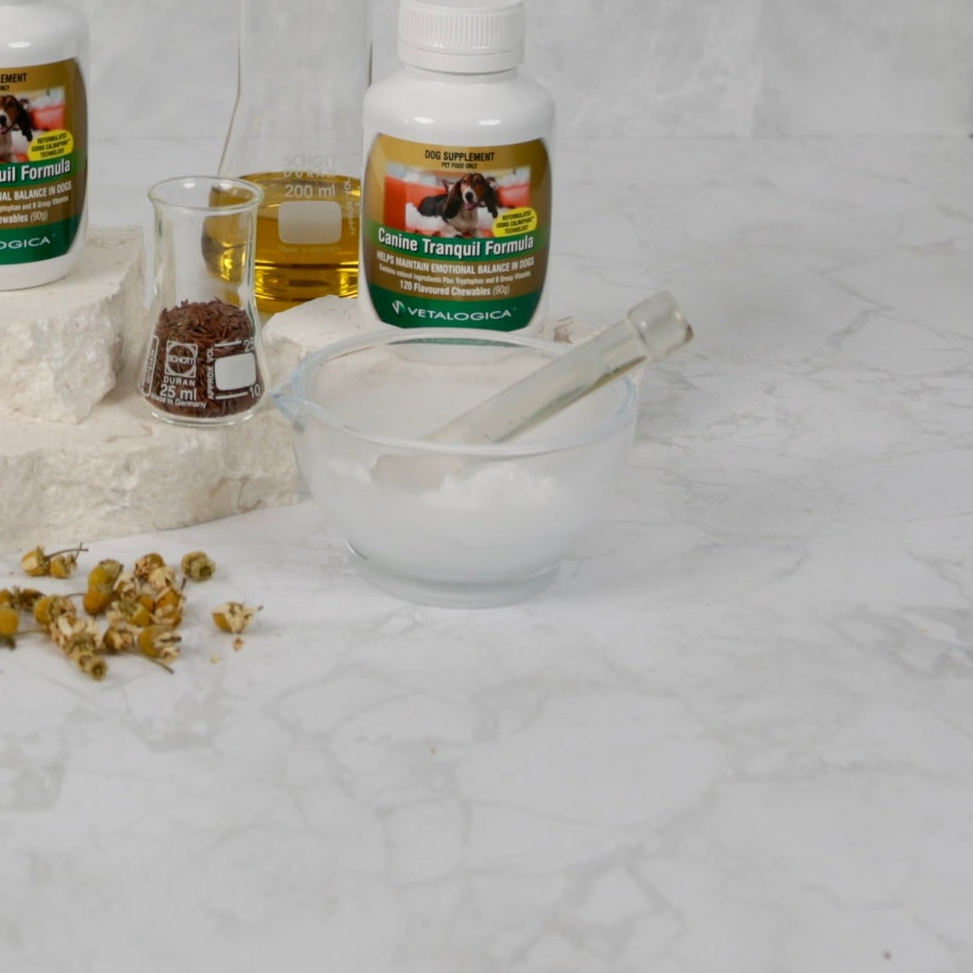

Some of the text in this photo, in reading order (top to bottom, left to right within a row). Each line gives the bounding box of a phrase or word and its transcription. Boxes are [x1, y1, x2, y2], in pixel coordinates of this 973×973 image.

[425, 150, 495, 162] DOG SUPPLEMENT
[20, 158, 70, 180] Formula
[14, 188, 47, 200] BALANCE
[48, 186, 56, 195] IN
[57, 181, 72, 192] DOGS
[284, 184, 336, 198] 200 ml
[378, 228, 534, 259] Canine Tranquil Formula
[376, 250, 534, 274] HELPS MAINTAIN EMOTIONAL BALANCE IN DOGS
[400, 280, 412, 290] 120
[414, 282, 449, 295] Flavoured
[451, 286, 490, 296] Chewables
[407, 307, 512, 321] VETALOGICA
[164, 376, 196, 386] DURAN
[160, 384, 197, 401] 25 ml
[249, 383, 261, 399] 10
